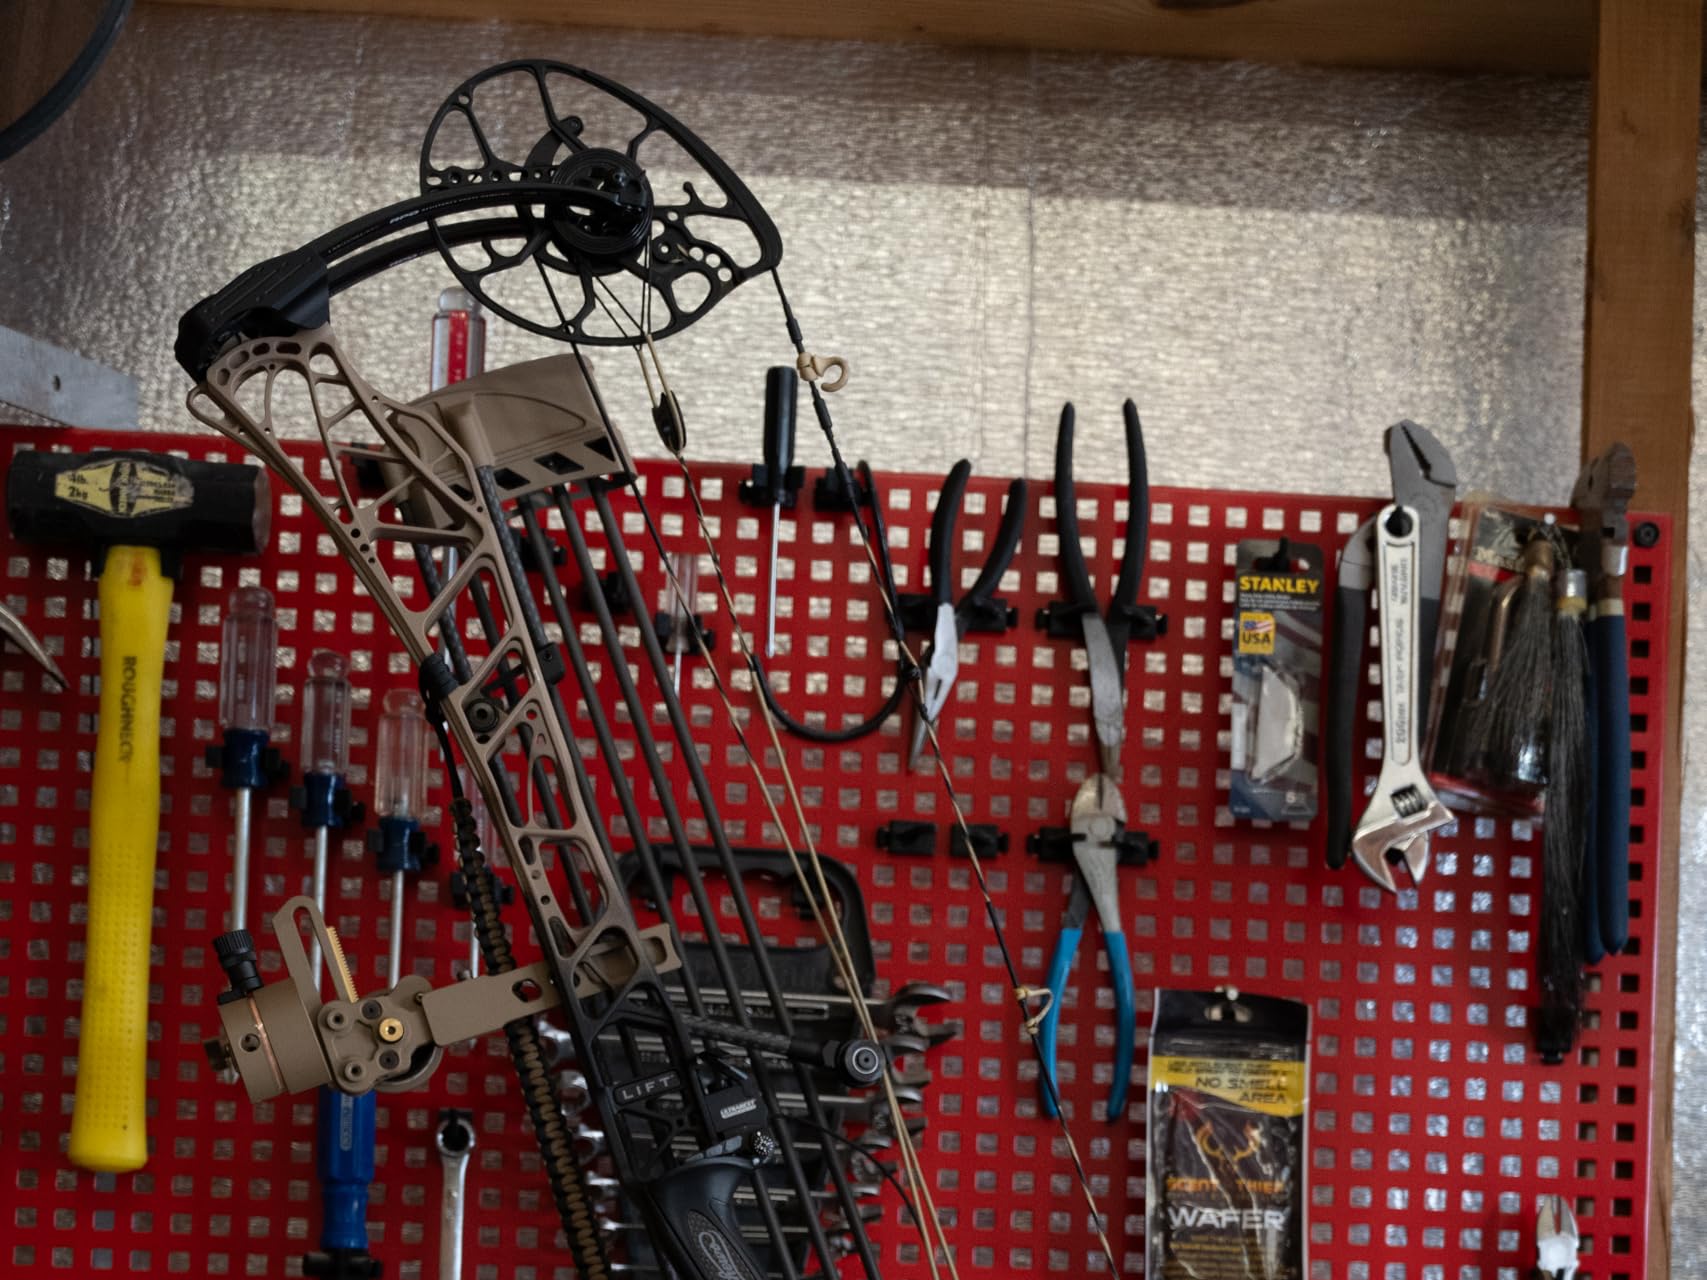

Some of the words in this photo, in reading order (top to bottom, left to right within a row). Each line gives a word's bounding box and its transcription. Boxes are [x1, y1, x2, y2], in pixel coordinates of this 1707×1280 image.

[1239, 575, 1320, 594] STANLEY
[1242, 632, 1271, 645] USA
[118, 655, 138, 763] ROUGHNECK
[621, 1076, 671, 1101] LIFT
[1195, 1077, 1222, 1089] NO
[1228, 1078, 1288, 1091] SMELL
[1239, 1091, 1287, 1103] AREA
[1167, 1206, 1286, 1231] WAFER
